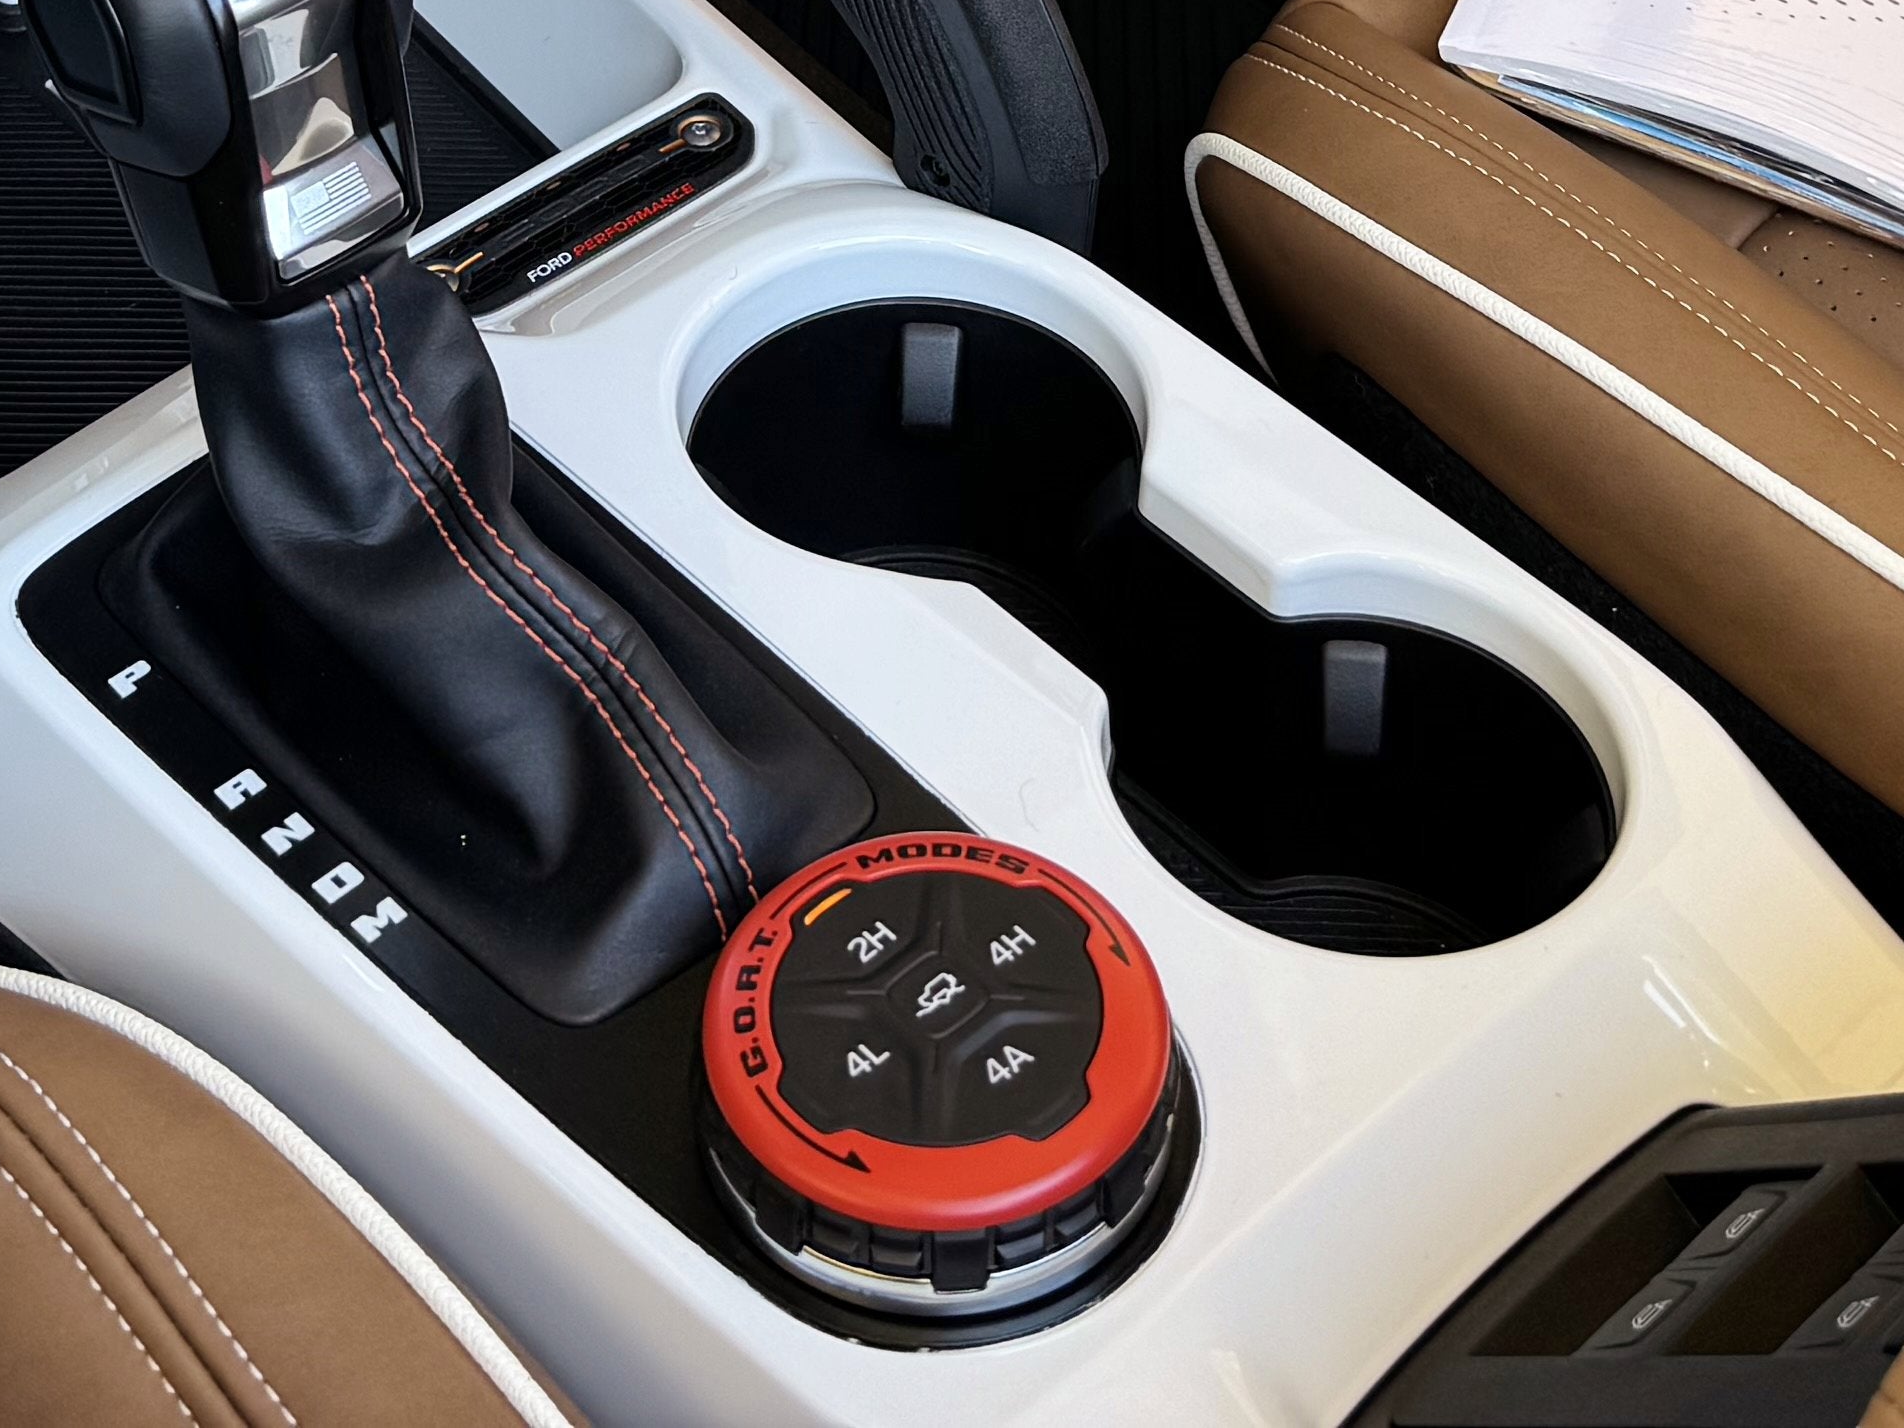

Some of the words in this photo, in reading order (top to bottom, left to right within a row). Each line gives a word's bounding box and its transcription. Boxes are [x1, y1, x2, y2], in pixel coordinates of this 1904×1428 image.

[526, 250, 574, 284] FORD
[573, 181, 696, 260] PERFORMANCE
[107, 659, 152, 700] P
[260, 811, 316, 857] N
[854, 842, 1030, 876] MODES
[311, 861, 366, 905] D
[350, 896, 409, 945] M
[846, 920, 899, 964] 2H
[989, 923, 1037, 968] 4H
[732, 927, 781, 1079] G.O.A.T.
[845, 1042, 892, 1079] 4L
[985, 1044, 1036, 1087] 4A
